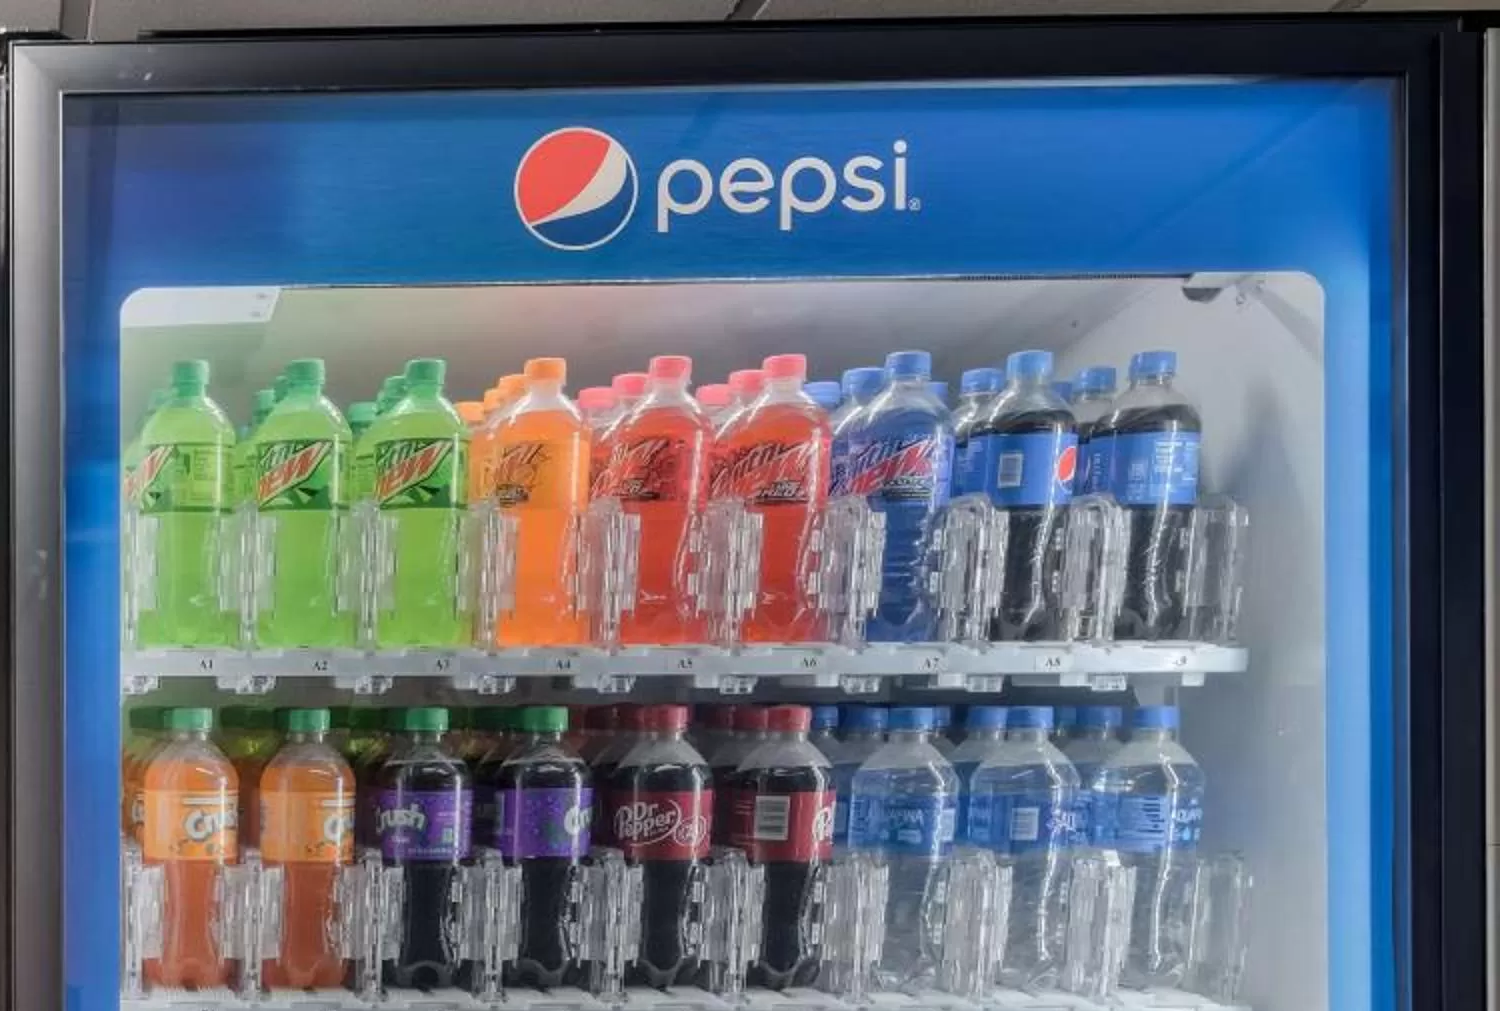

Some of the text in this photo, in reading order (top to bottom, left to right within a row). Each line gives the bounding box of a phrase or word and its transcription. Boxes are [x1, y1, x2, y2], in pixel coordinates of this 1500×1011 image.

[657, 139, 907, 233] pepsi
[199, 659, 214, 670] A1
[313, 660, 329, 671] A2
[923, 658, 940, 669] A7
